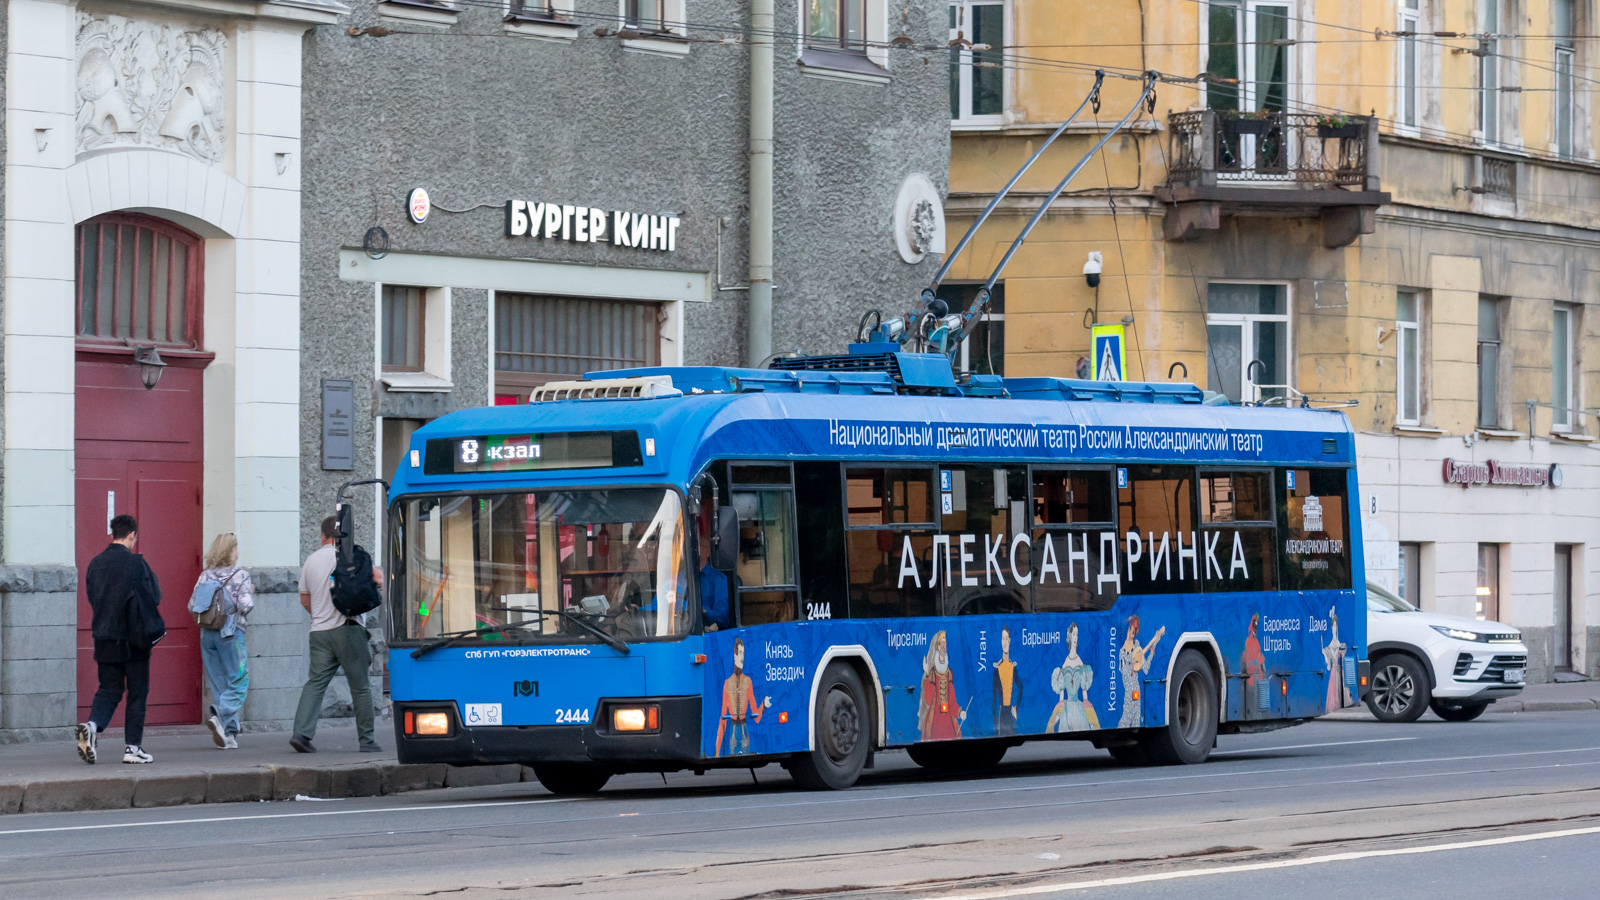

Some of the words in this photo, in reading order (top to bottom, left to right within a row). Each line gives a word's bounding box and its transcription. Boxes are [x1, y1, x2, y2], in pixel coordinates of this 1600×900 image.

[509, 199, 607, 243] БУРГЕР
[613, 210, 681, 252] КИНГ
[829, 418, 933, 448] Национальный
[936, 422, 1039, 451] драматический
[1041, 428, 1077, 453] театр
[1079, 423, 1122, 449] России
[1125, 424, 1229, 454] Александринский
[1231, 433, 1263, 456] театр
[461, 439, 479, 463] 8
[487, 444, 541, 459] кзал
[1445, 458, 1489, 488] Старик
[1329, 540, 1343, 554] ТЕАТР
[897, 531, 1249, 595] АЛЕКСАНДРИНКА
[806, 602, 831, 620] 2444
[1263, 615, 1300, 634] Баронесса
[1309, 615, 1328, 633] Дама
[886, 629, 927, 650] Тирселин
[1022, 628, 1061, 648] Барышня
[1263, 635, 1291, 654] Штраль
[465, 650, 482, 659] СПб
[483, 650, 500, 658] ГУП
[501, 648, 591, 657] «ГОРЭЛЕКТРОТРАНС»
[765, 641, 794, 659] Князь
[978, 630, 987, 672] Улан
[765, 663, 805, 682] Звездич
[1108, 627, 1117, 711] Ковьелло
[555, 708, 589, 724] 2444
